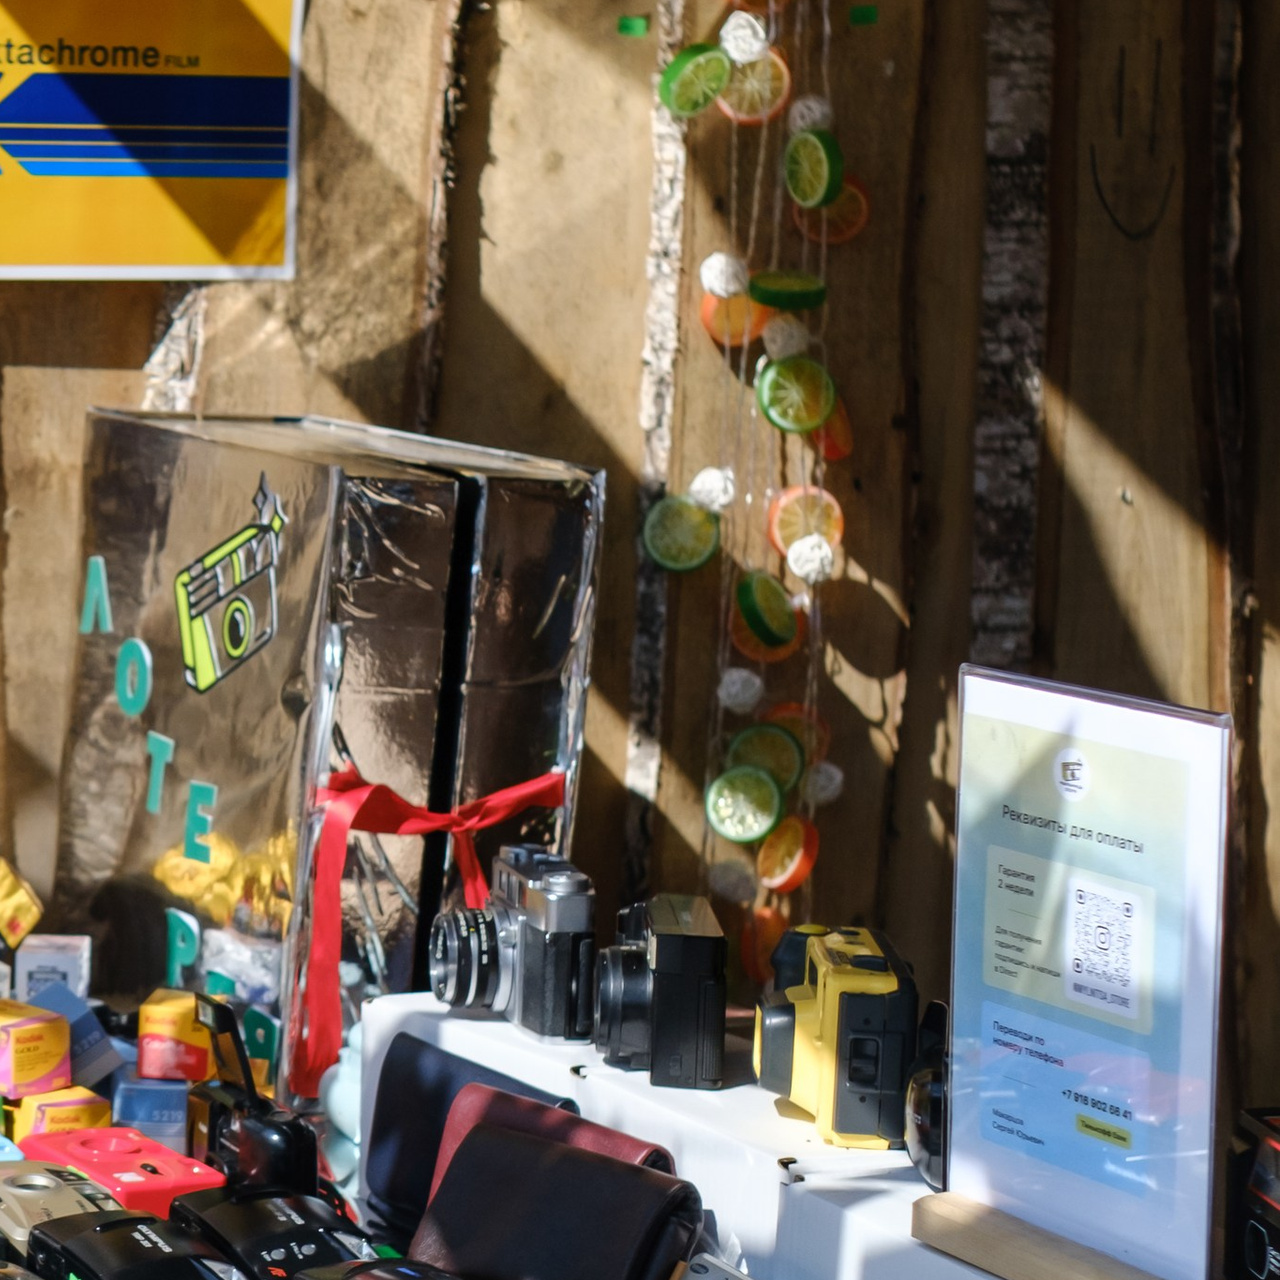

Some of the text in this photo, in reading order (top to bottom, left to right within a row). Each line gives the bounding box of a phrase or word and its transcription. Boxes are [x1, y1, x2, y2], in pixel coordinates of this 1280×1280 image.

[164, 54, 201, 69] FILM
[1001, 804, 1145, 855] Реквизиты для оплаты
[997, 864, 1036, 883] Гарантия
[997, 878, 1035, 897] 2 недели
[15, 1033, 44, 1044] Kodak
[992, 1020, 1046, 1046] Переводи по
[15, 1045, 40, 1054] GOLD
[992, 1037, 1065, 1068] номеру телефона
[1062, 1089, 1072, 1101] +7
[49, 1114, 81, 1123] Kodak
[151, 1109, 184, 1122] 5219
[136, 1224, 174, 1253] OLYMPUS
